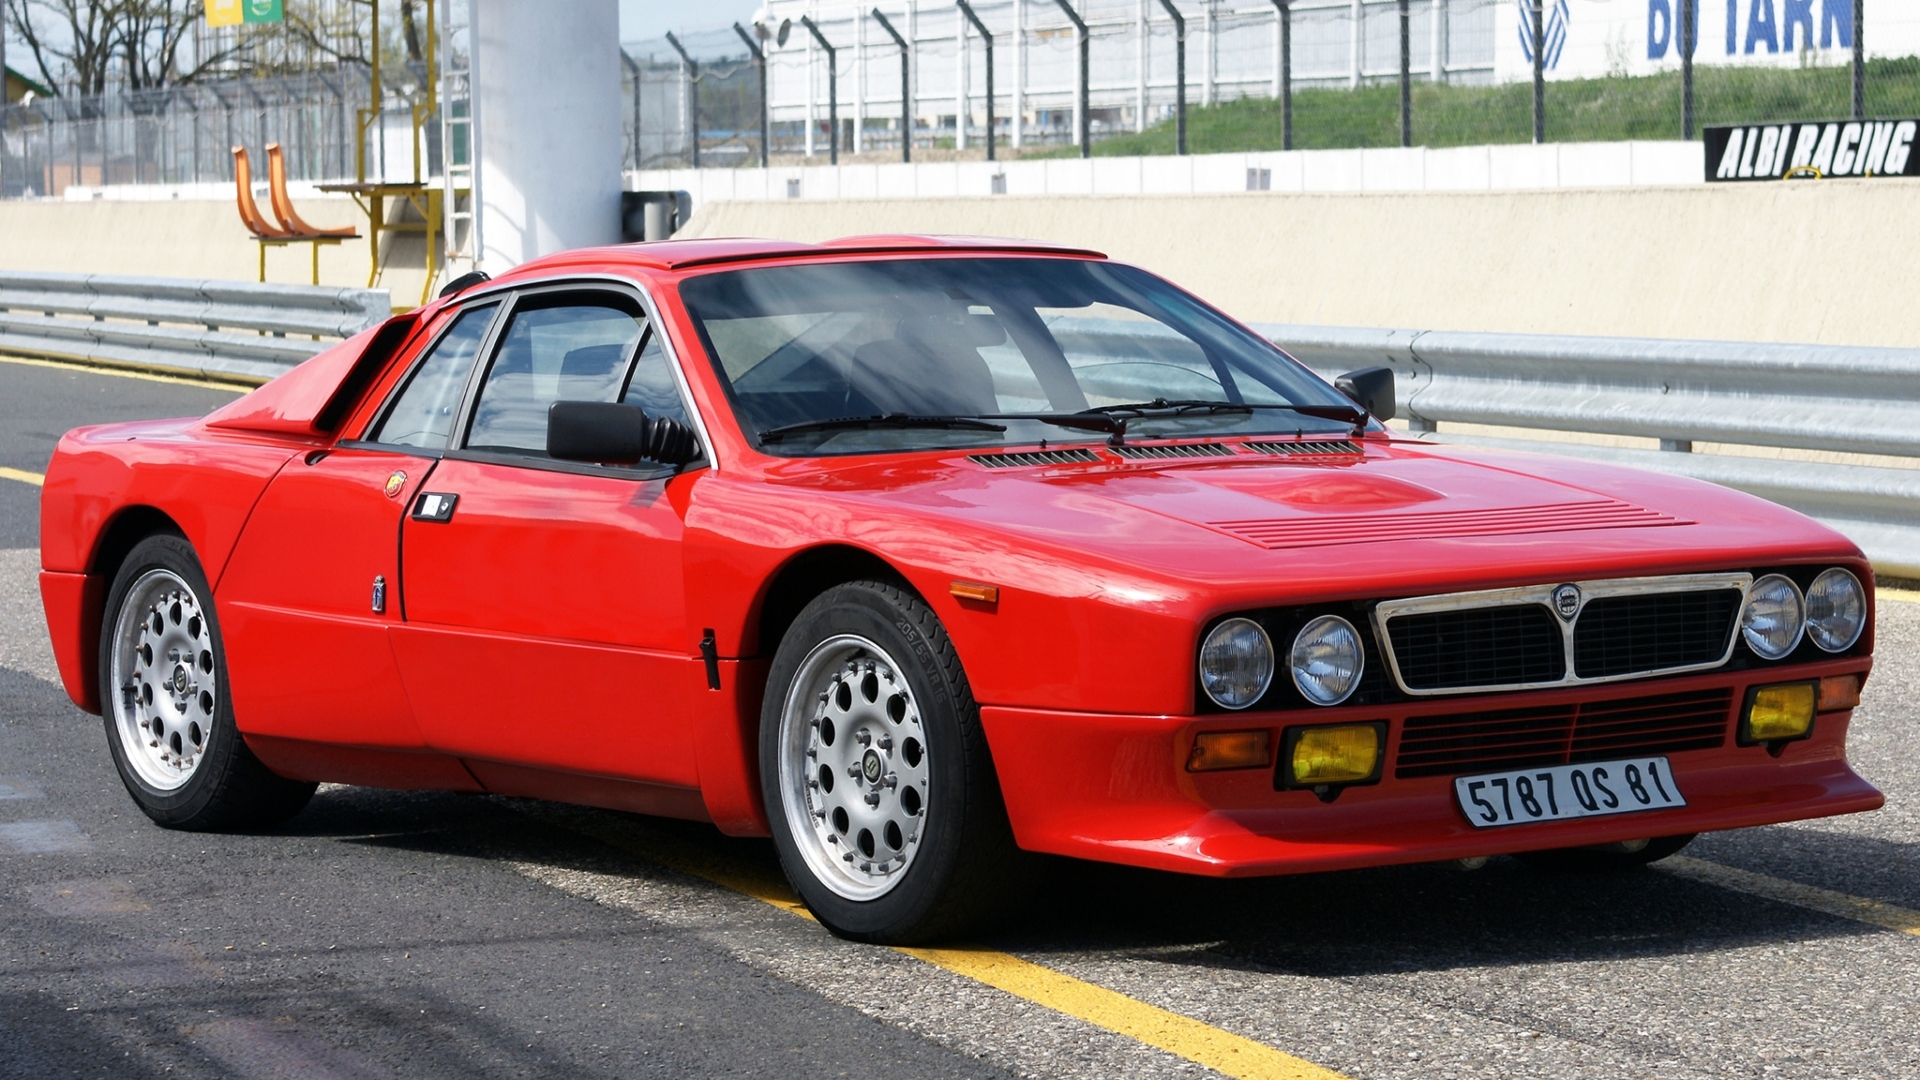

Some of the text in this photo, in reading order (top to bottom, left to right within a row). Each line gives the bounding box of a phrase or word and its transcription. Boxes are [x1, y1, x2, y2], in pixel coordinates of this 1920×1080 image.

[1716, 121, 1917, 178] ALBI RACING
[895, 617, 947, 703] 205/55 VR 16
[1468, 762, 1672, 822] 5787 QS 81
